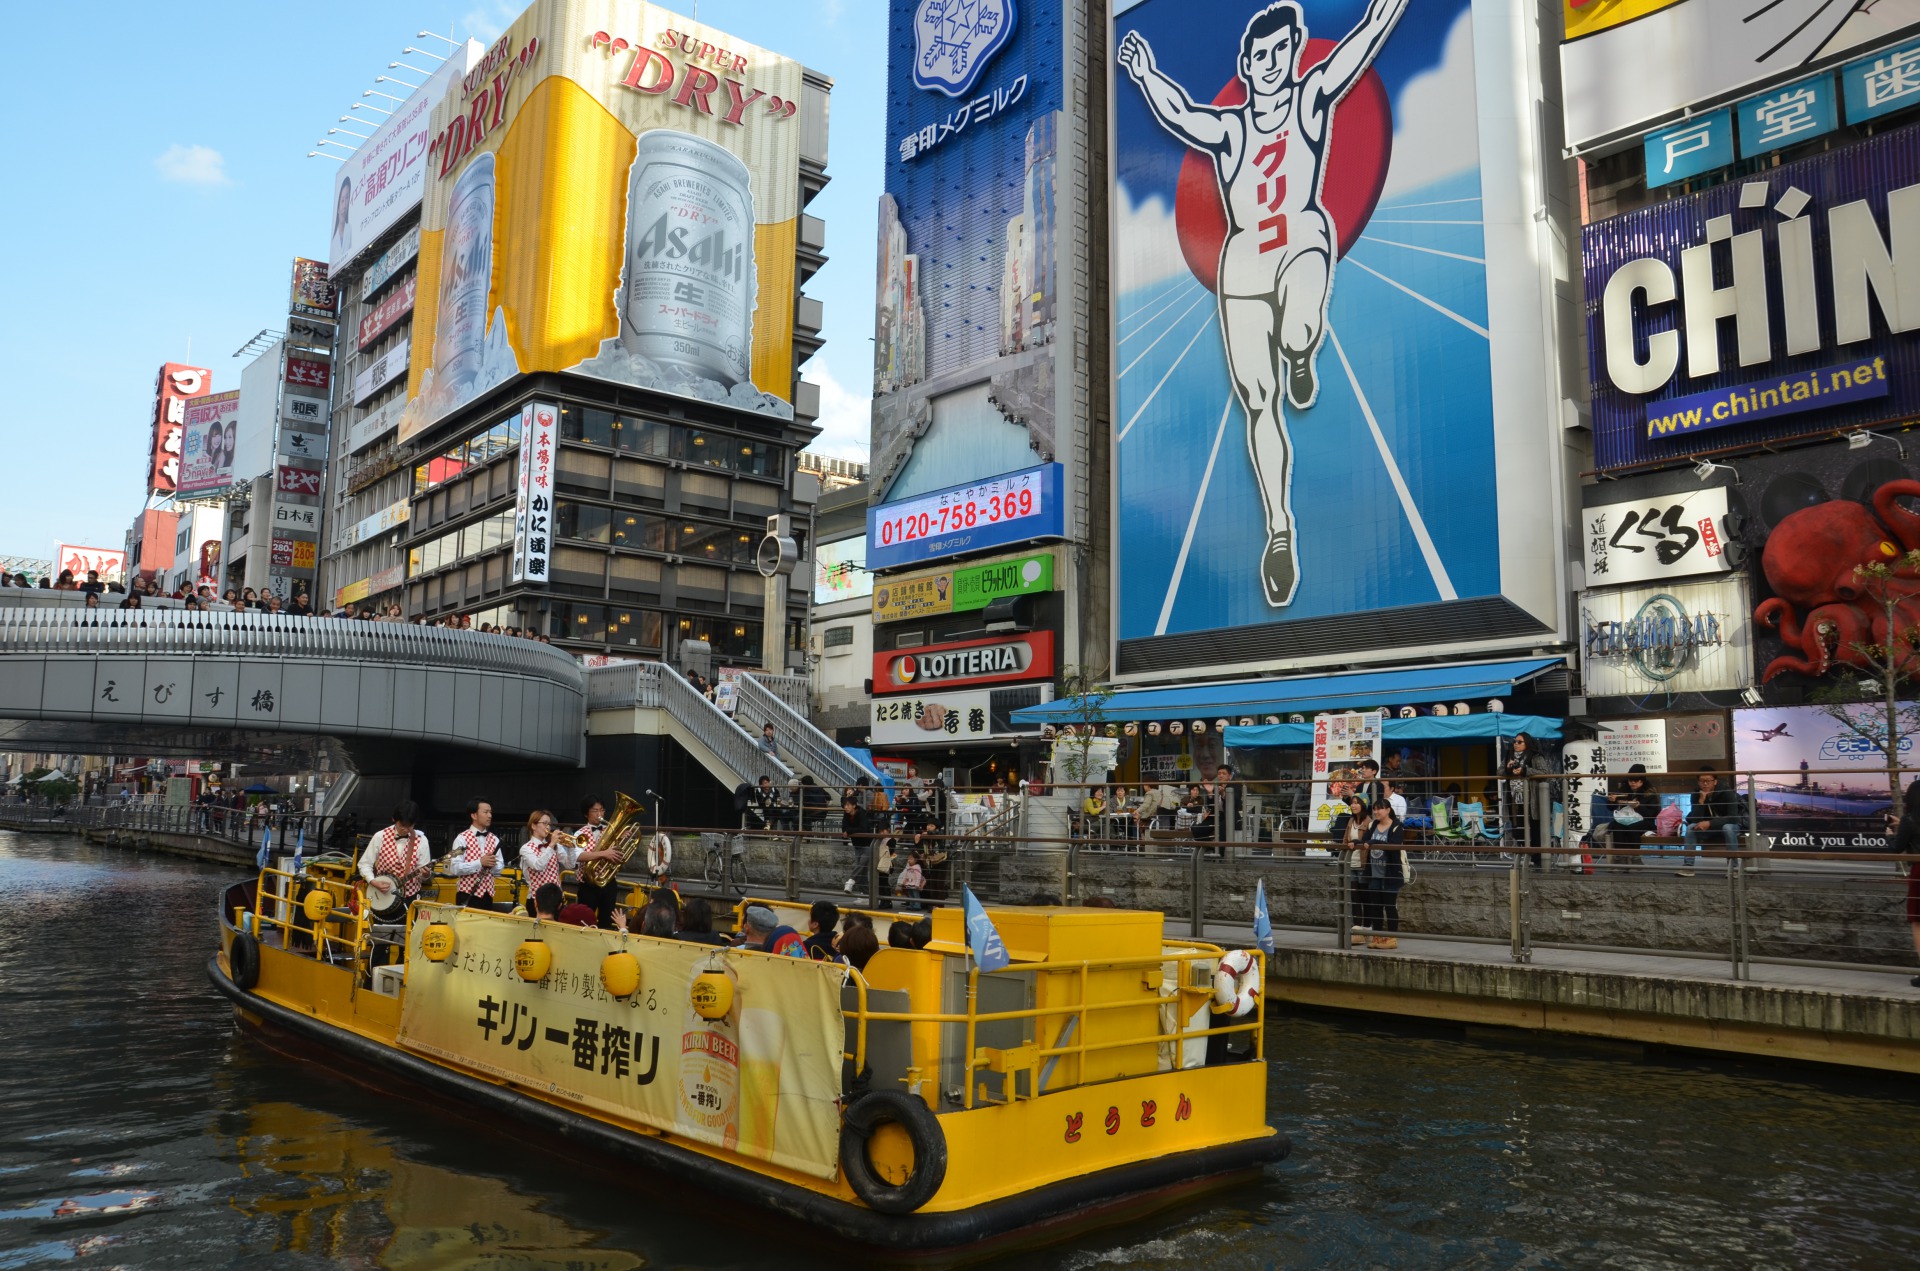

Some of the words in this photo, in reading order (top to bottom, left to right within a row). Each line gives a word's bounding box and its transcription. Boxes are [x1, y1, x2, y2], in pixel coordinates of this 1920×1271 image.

[661, 28, 748, 75] SUPER
[462, 35, 510, 101] SUPER
[899, 73, 1028, 163] 雪印メグミルク
[364, 129, 428, 206] 高須クリニッ
[653, 182, 671, 200] ASAHI
[673, 178, 711, 197] BREWERIES
[713, 193, 733, 222] LIMITED
[1252, 129, 1290, 255] グリコ
[684, 203, 704, 213] SUPER
[637, 211, 742, 283] Asahi
[296, 303, 307, 312] 9F
[674, 281, 705, 308] 生
[455, 301, 468, 325] 生
[659, 304, 719, 327] スーパードライ
[674, 340, 700, 357] 350ml
[189, 405, 221, 426] 高収入
[292, 400, 319, 417] 和民
[535, 431, 551, 489] 本場の味
[940, 474, 1031, 506] なごやかミルク
[276, 506, 314, 525] 白木屋
[881, 488, 1033, 545] 0120-758-369
[928, 535, 972, 553] 雪印メグミルク
[1590, 513, 1609, 577] 道頓堀
[1609, 504, 1699, 565] くくる
[65, 553, 119, 577] かに
[294, 548, 315, 561] 280円
[981, 565, 1019, 593] ピタットハウス
[920, 645, 1020, 679] LOTTERIA
[101, 680, 275, 713] えびす橋
[876, 699, 925, 722] たこ焼き
[943, 708, 985, 735] 壱番
[1315, 720, 1328, 773] 大阪名物
[1781, 832, 1815, 847] don't
[1820, 836, 1846, 849] you
[1851, 833, 1889, 848] choo
[691, 994, 718, 1004] 一番搾り
[684, 1034, 710, 1050] KIRIN
[712, 1037, 736, 1062] BEER
[691, 1090, 722, 1111] 一番搾り
